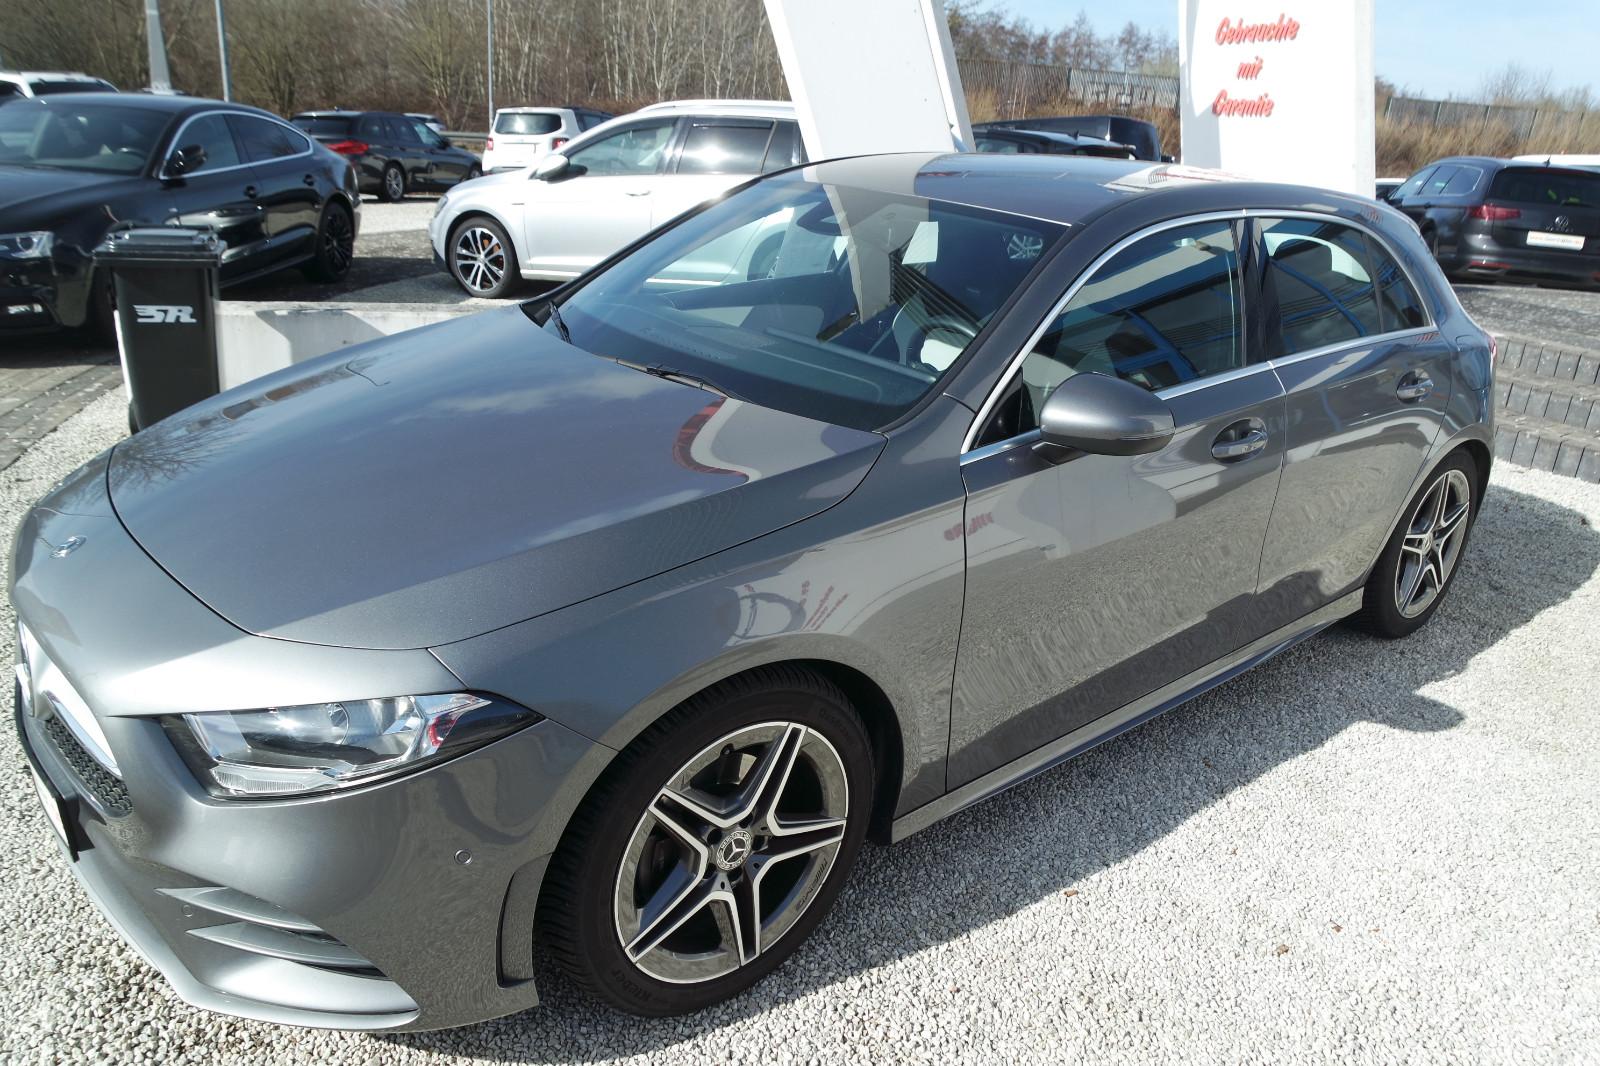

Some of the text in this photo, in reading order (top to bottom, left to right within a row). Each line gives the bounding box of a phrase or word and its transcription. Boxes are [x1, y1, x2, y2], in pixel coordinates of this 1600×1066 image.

[1215, 13, 1300, 45] Gebrauchte
[1237, 55, 1263, 80] mit
[1212, 88, 1275, 117] Garantie
